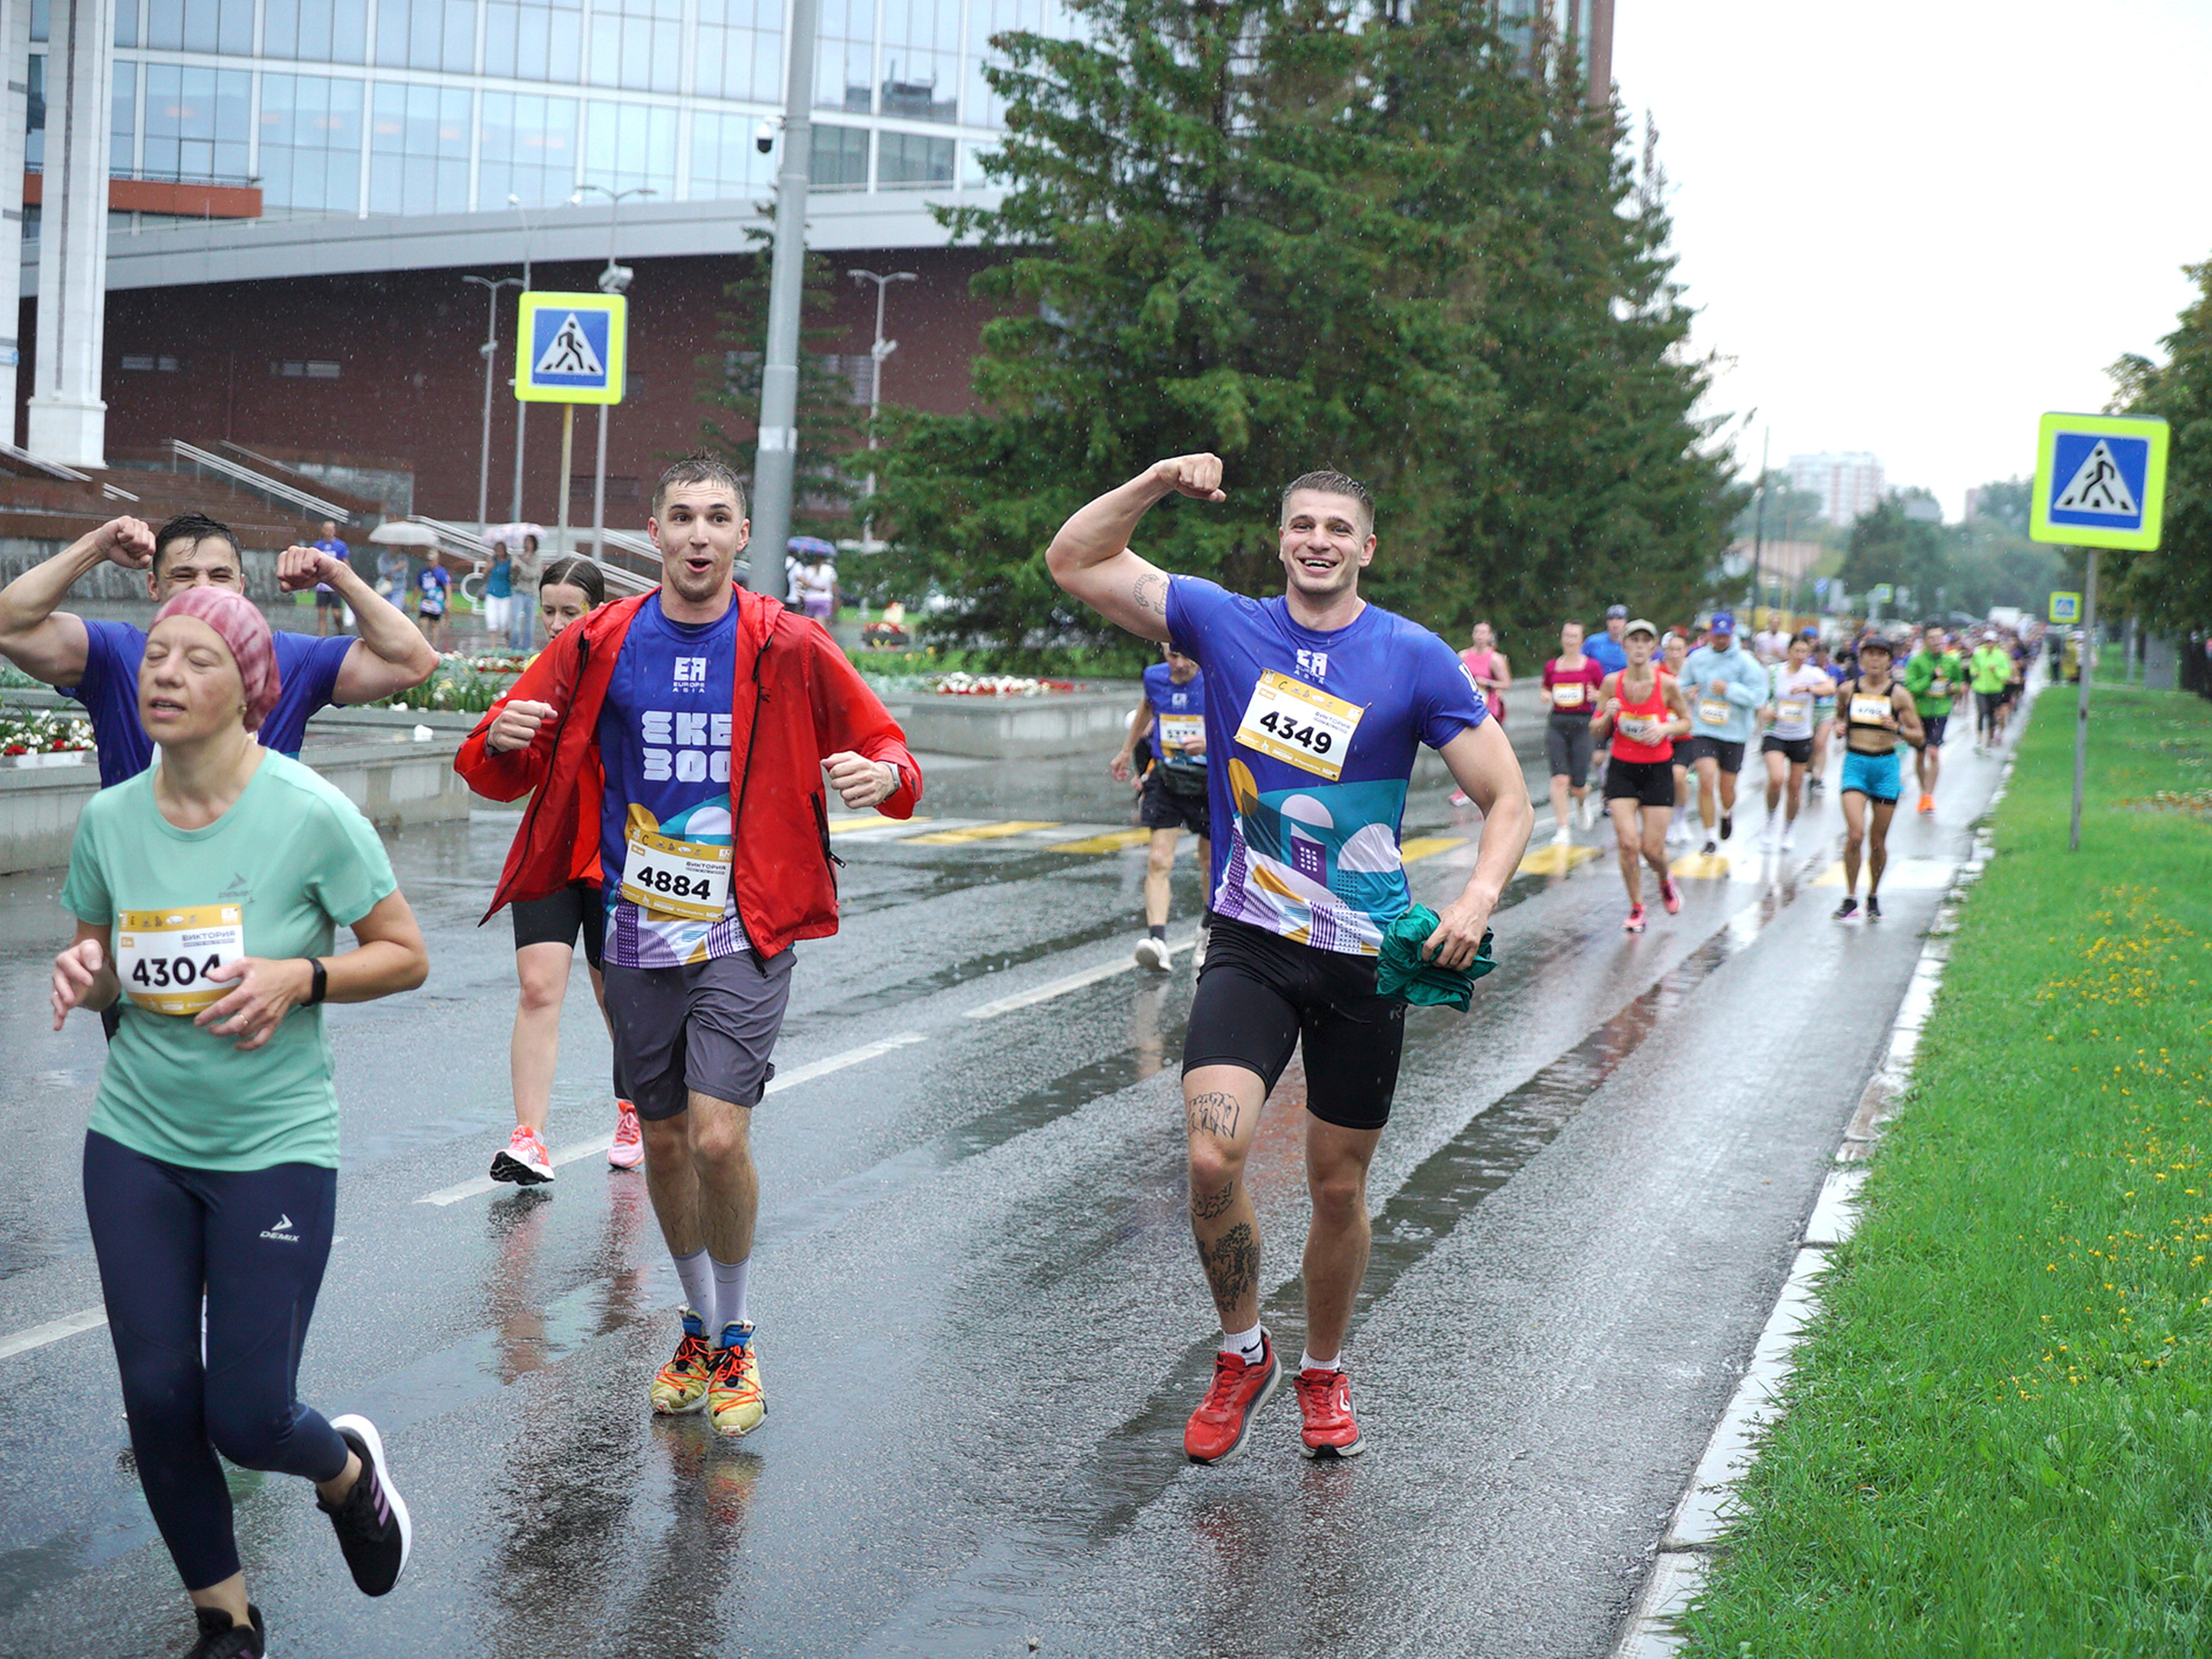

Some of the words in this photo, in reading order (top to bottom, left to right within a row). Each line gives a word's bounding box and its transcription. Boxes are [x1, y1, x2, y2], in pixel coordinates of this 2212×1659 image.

[1260, 711, 1332, 754] 4349
[637, 866, 711, 900] 4884
[181, 930, 236, 941] ВИКТОРИЯ
[132, 953, 221, 987] 4304
[259, 1230, 300, 1242] DEMIX
